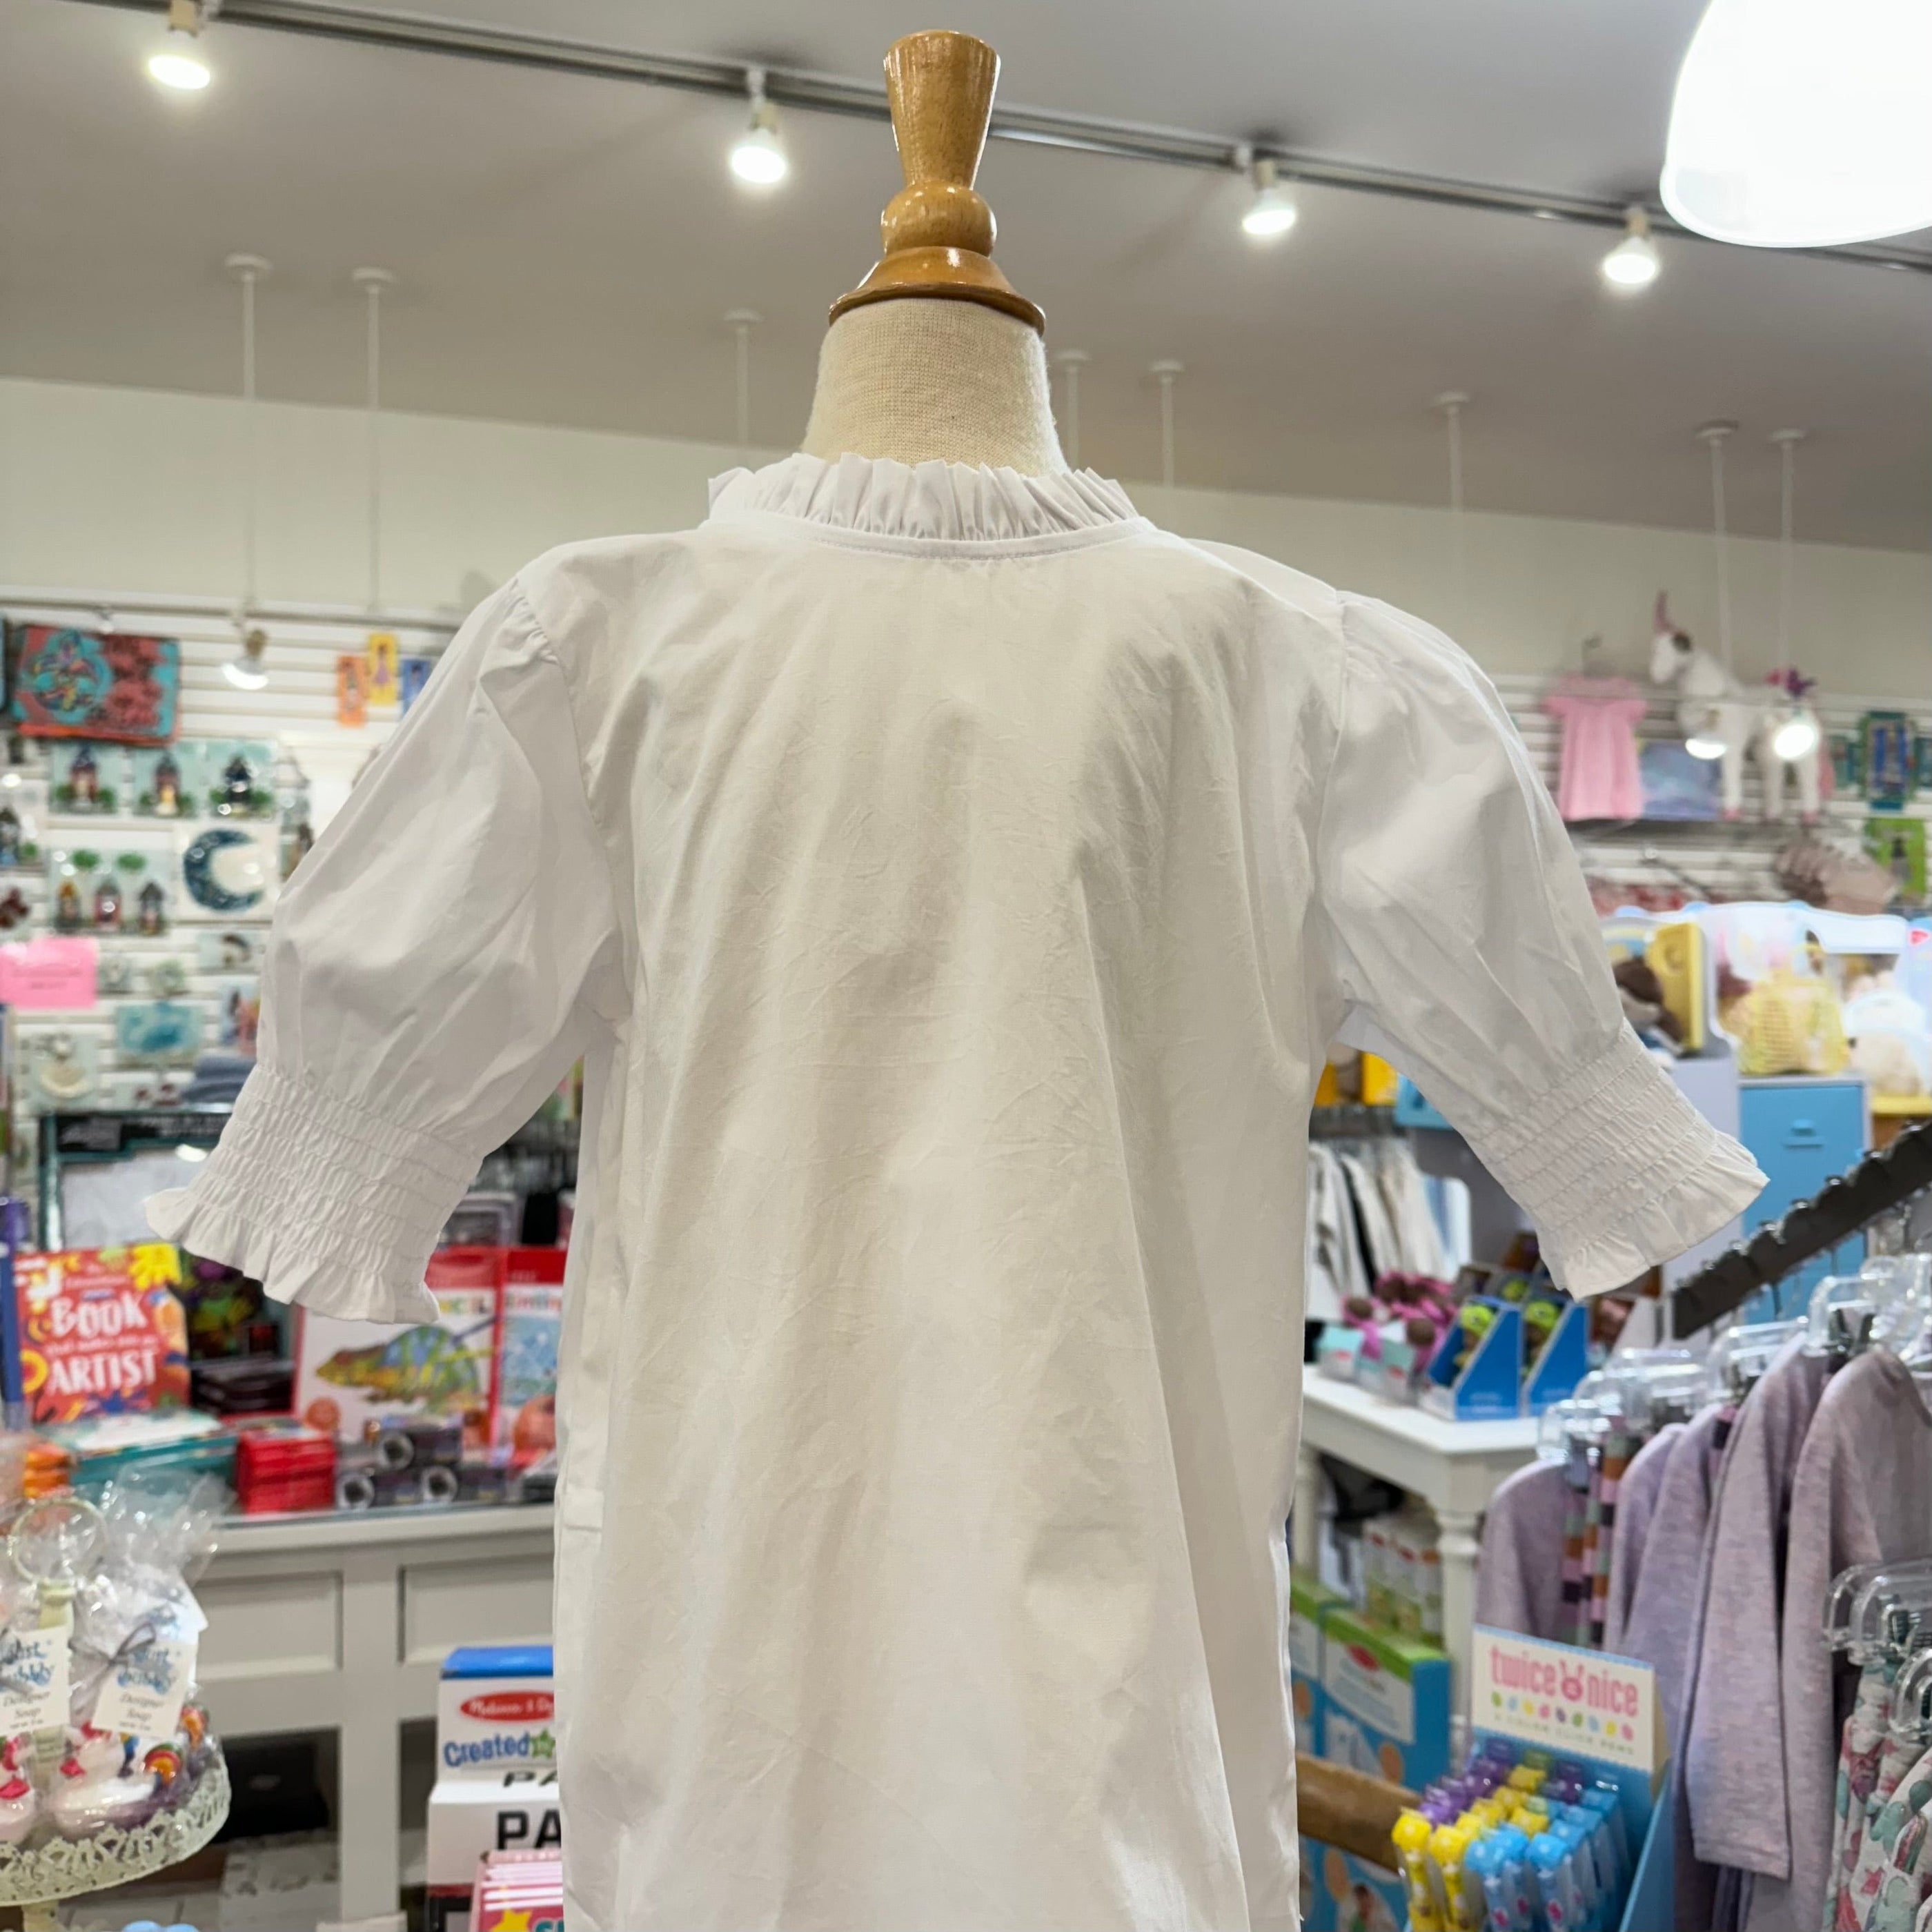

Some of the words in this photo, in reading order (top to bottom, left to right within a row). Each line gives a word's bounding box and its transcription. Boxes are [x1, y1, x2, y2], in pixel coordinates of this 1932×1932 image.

[51, 1291, 147, 1339] BOOK
[44, 1349, 159, 1396] ARTIST
[1490, 1646, 1557, 1697] twice
[1588, 1670, 1638, 1717] nice
[444, 1731, 531, 1768] Created
